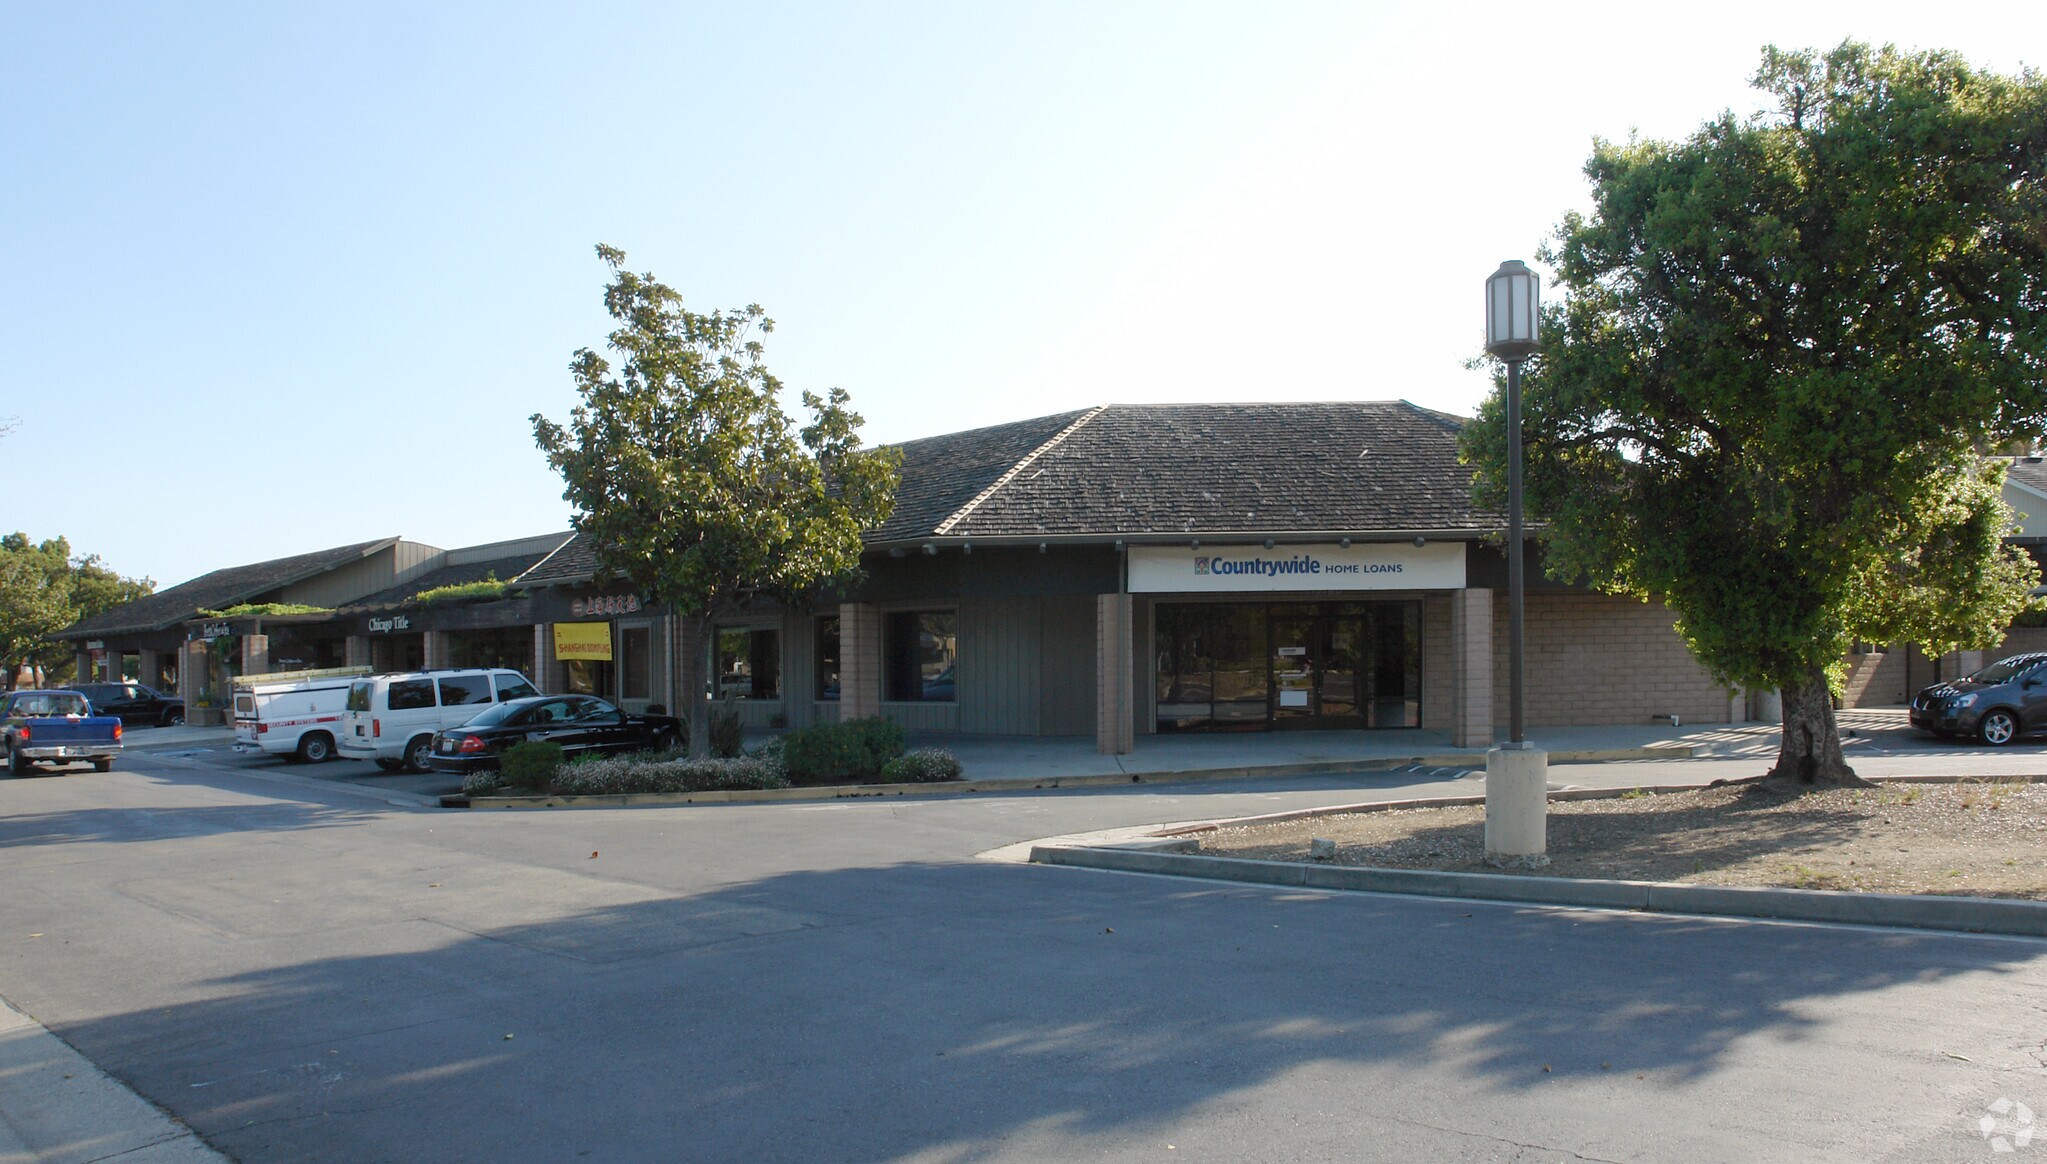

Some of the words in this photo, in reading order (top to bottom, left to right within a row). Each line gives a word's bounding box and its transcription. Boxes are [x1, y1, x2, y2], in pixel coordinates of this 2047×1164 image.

[1210, 555, 1320, 576] Countrywide
[1325, 564, 1359, 574] HOME
[1363, 564, 1403, 573] LOANS
[368, 617, 393, 633] Chicago
[393, 615, 409, 629] Title
[558, 643, 586, 654] SHANGHAI
